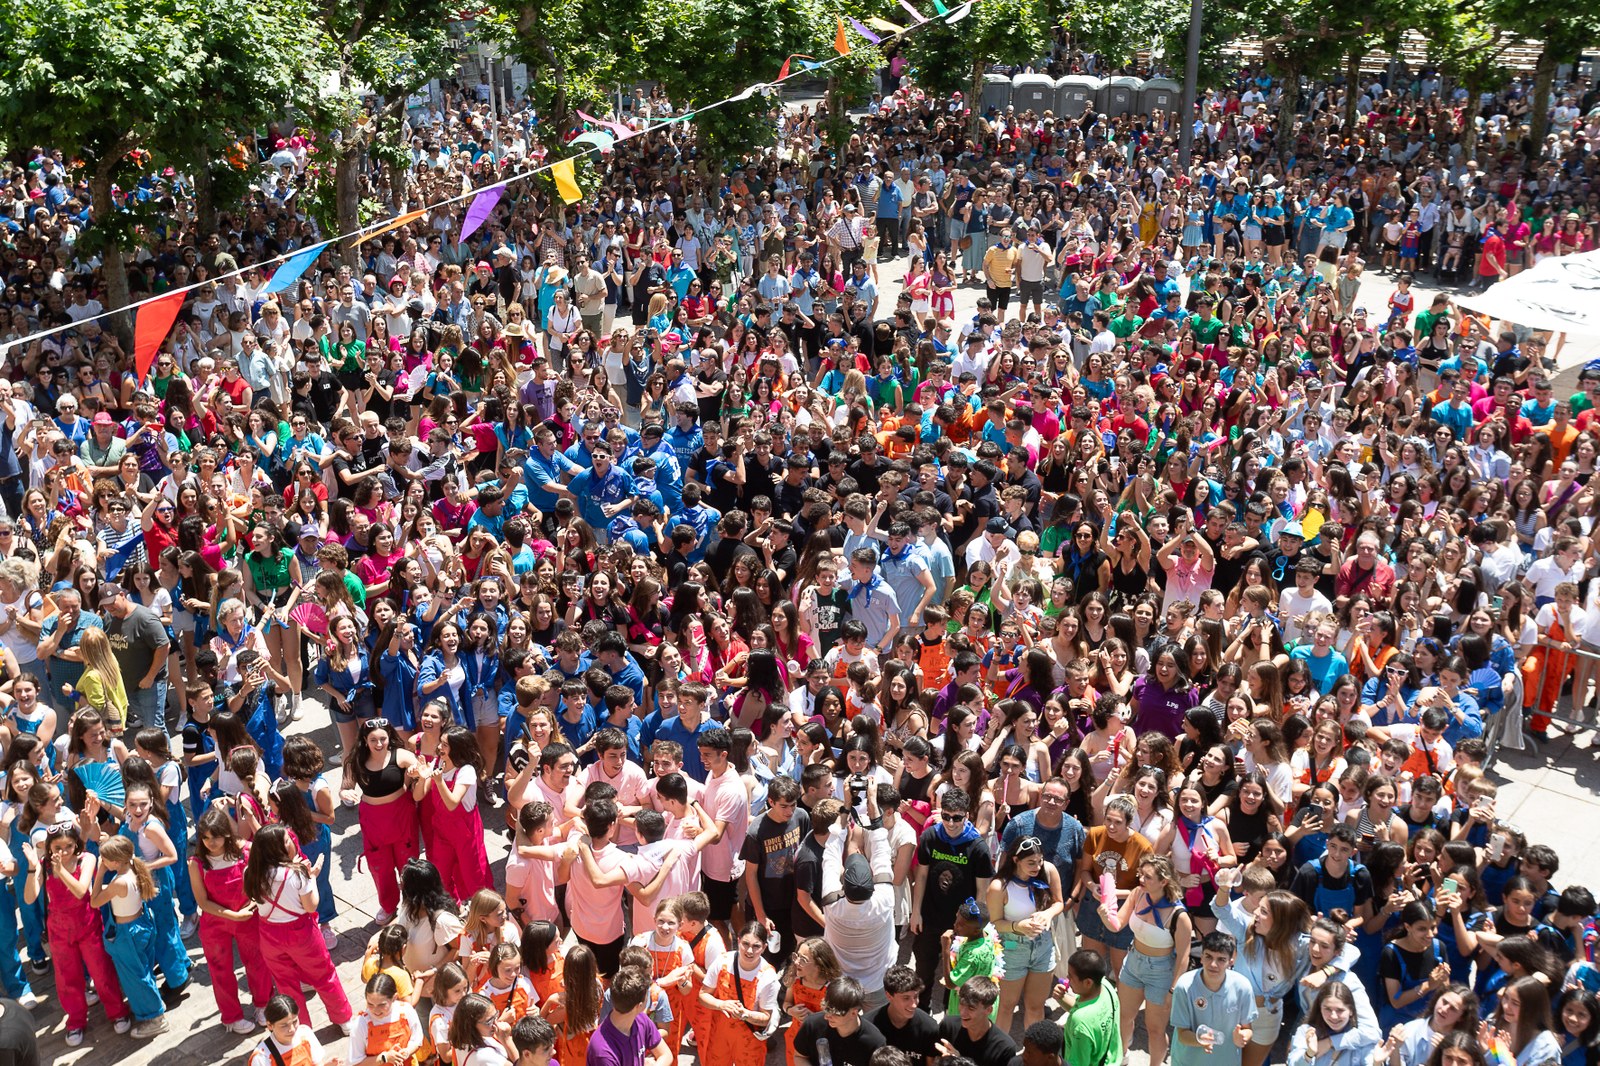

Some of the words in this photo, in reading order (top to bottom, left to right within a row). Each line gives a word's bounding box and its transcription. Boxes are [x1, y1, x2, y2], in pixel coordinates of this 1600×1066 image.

[764, 835, 782, 846] EDDIE
[783, 831, 793, 841] AND
[765, 842, 784, 853] HOT
